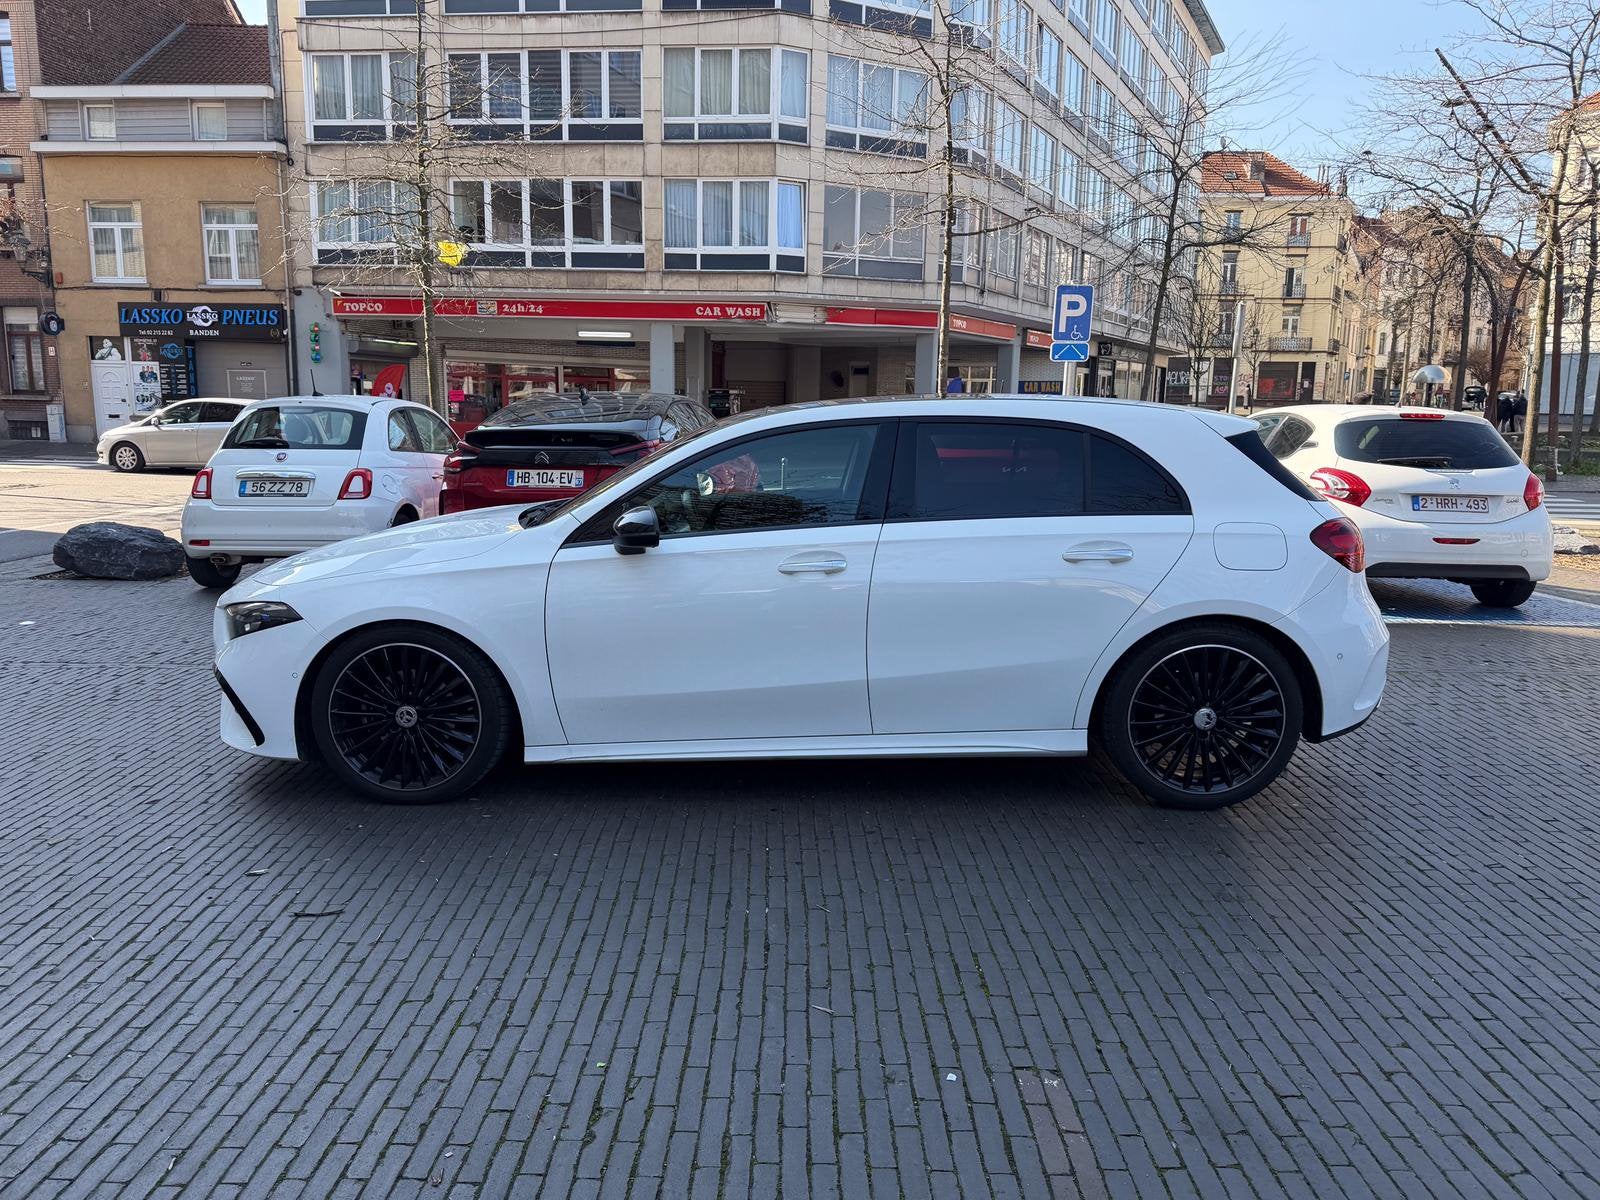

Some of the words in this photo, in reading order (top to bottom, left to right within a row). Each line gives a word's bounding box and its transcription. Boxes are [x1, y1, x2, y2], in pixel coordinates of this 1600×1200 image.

[343, 302, 382, 312] TOPCO
[502, 303, 543, 314] 24h/24
[695, 306, 721, 316] CAR
[725, 307, 761, 317] WASH
[120, 307, 183, 325] LASSKO
[222, 309, 279, 326] PNEUS
[186, 312, 219, 320] LASSKO
[1059, 294, 1087, 333] P
